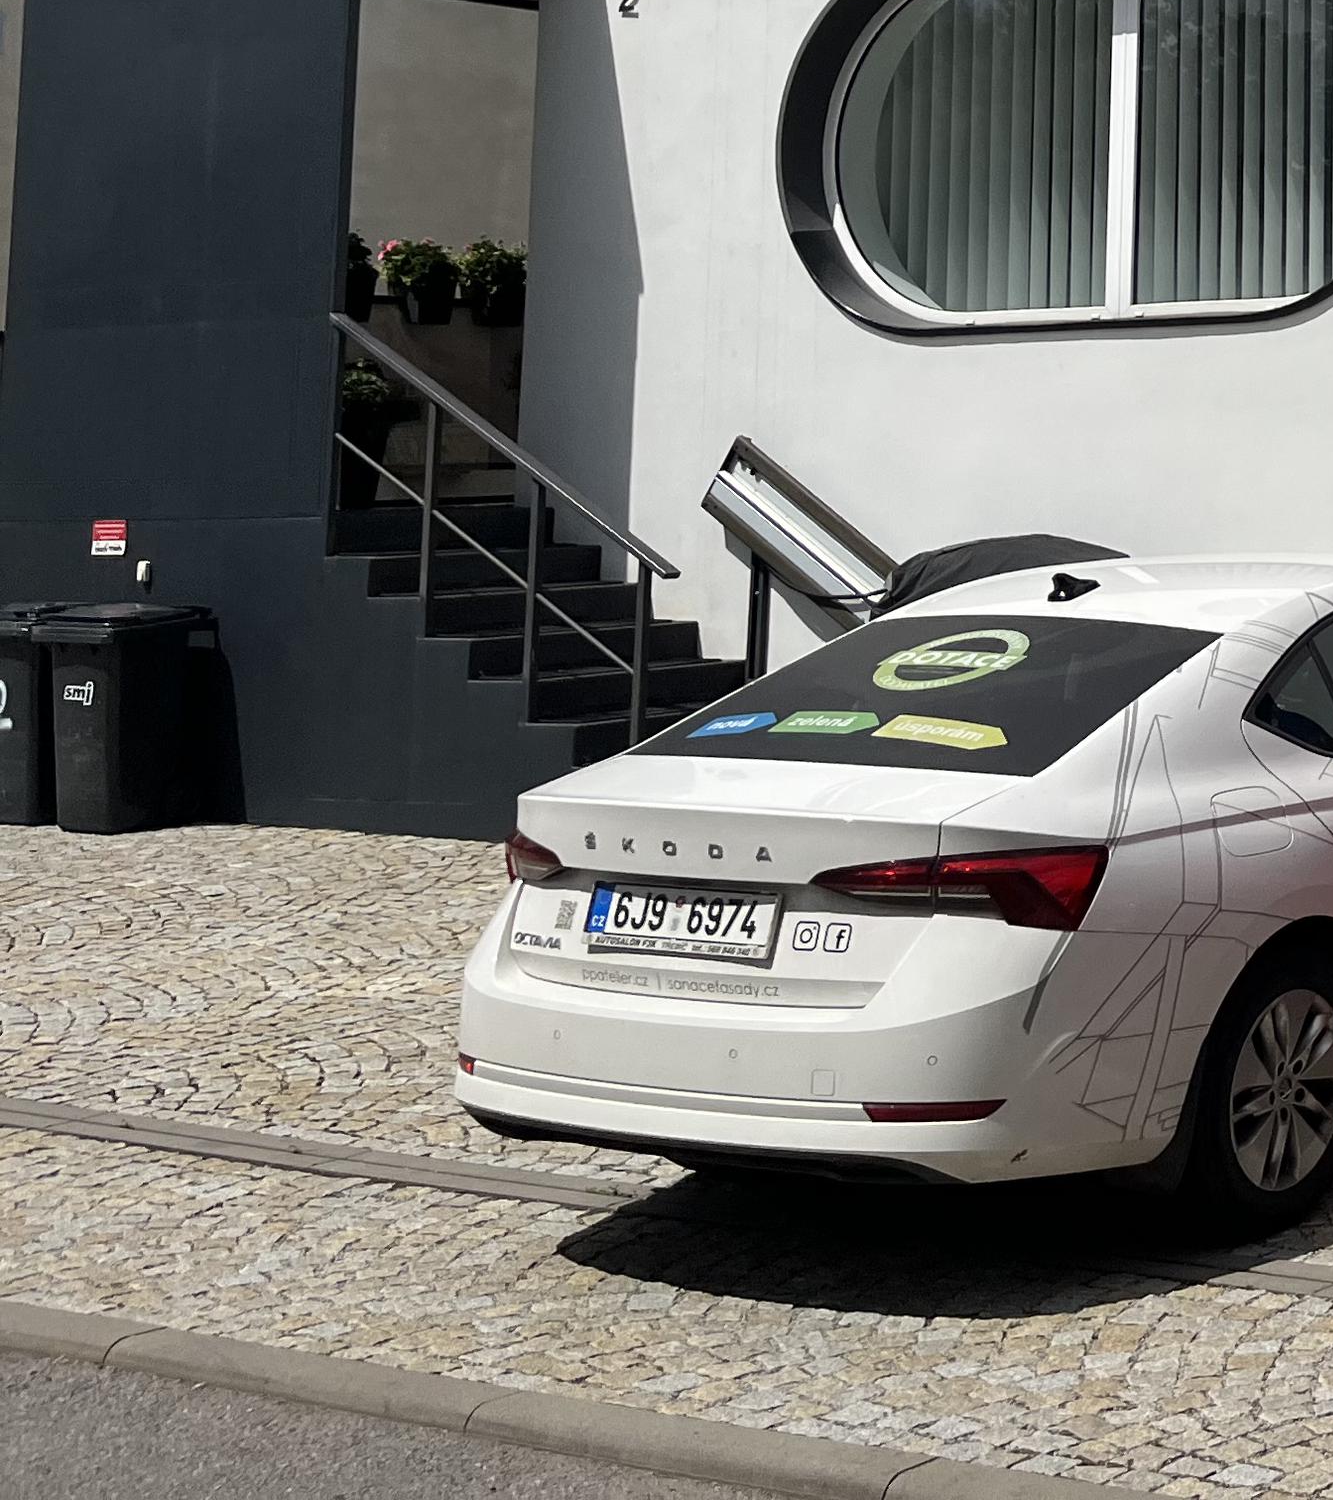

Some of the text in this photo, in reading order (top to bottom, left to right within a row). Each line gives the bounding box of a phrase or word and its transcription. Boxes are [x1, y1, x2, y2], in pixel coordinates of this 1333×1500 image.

[889, 650, 1018, 669] DOTACE
[63, 681, 94, 706] smj
[706, 713, 984, 742] nová zelená úsporám
[584, 831, 772, 863] ŠKODA
[613, 891, 758, 939] 6J9 6974
